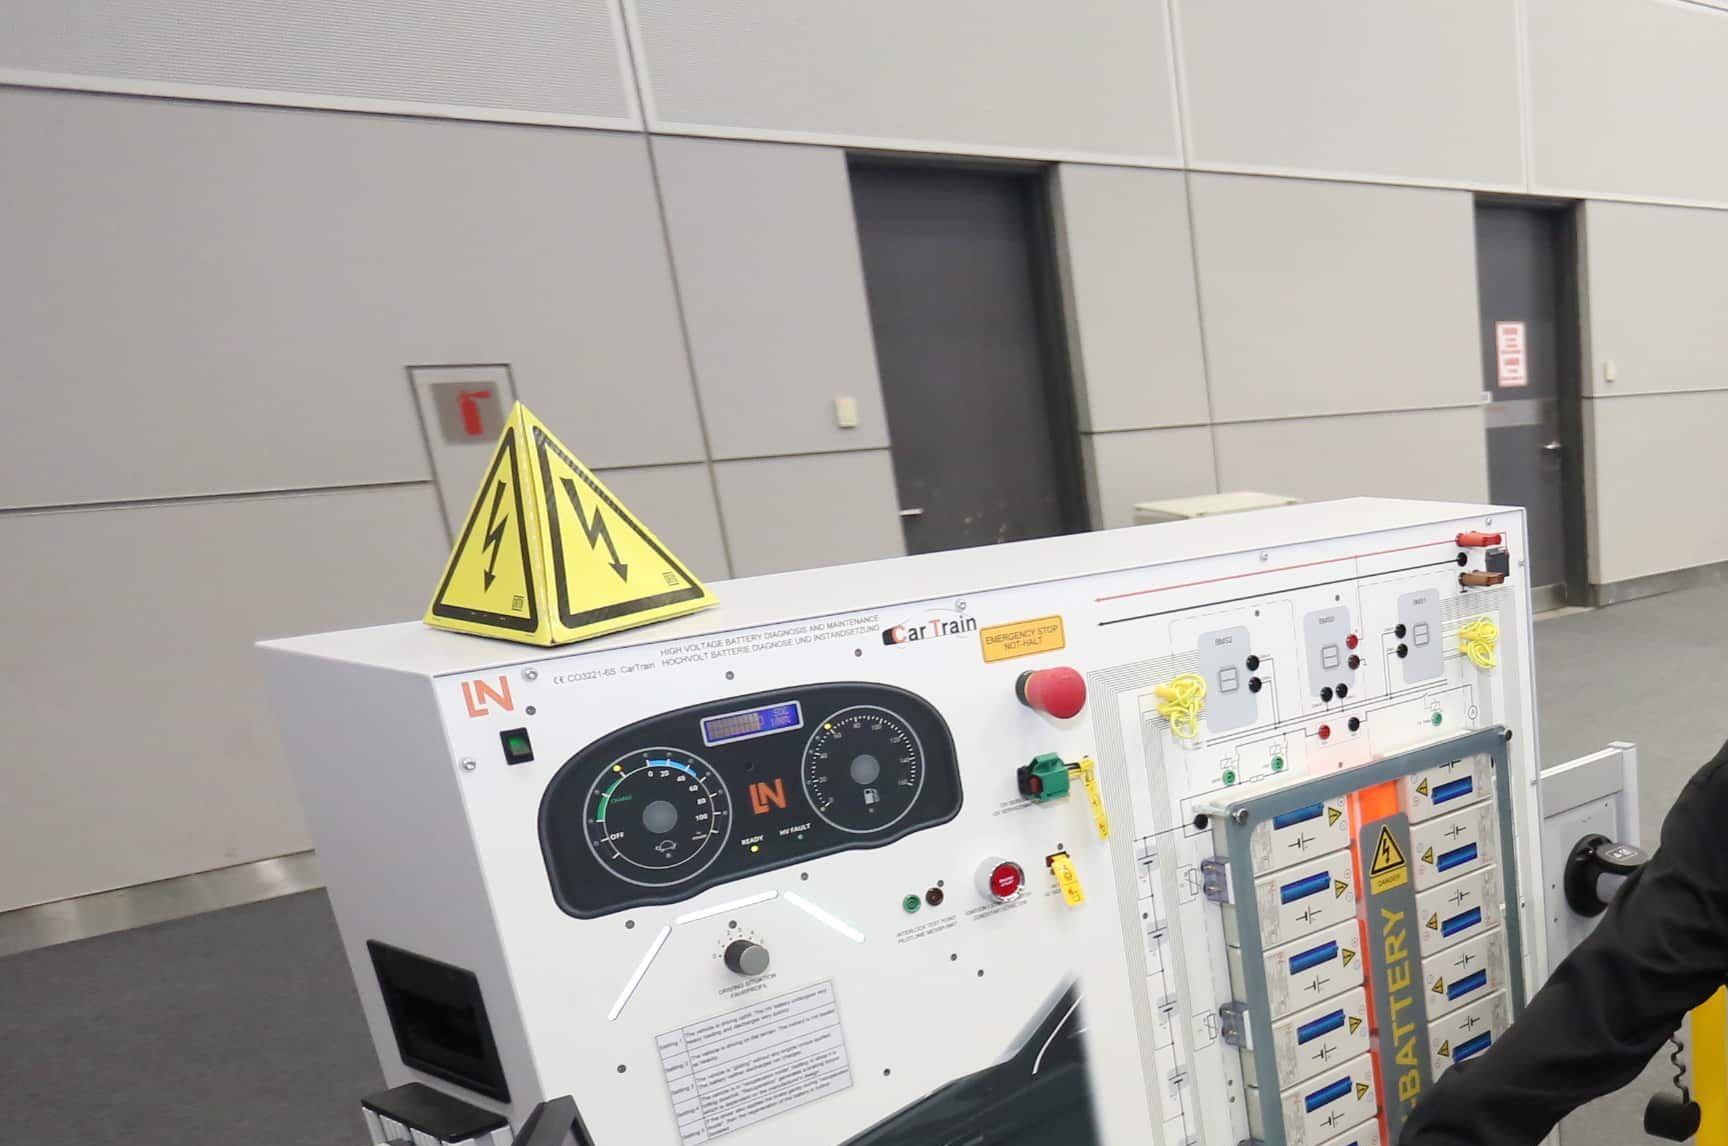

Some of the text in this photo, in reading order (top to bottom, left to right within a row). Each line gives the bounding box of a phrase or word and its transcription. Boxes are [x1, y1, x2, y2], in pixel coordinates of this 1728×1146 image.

[660, 614, 880, 657] HIGH VOLTAGE BATTERY DIAGNOSIS AND MAINTENANCE
[985, 624, 1059, 645] EMERGENCY STOP
[661, 652, 709, 667] HOCHVOLT
[461, 676, 514, 718] LN
[748, 778, 788, 815] LN
[695, 813, 708, 821] 100
[610, 831, 625, 841] OFF
[790, 823, 812, 834] FAULT
[741, 834, 764, 846] READY
[1381, 908, 1421, 1123] -BATTERY
